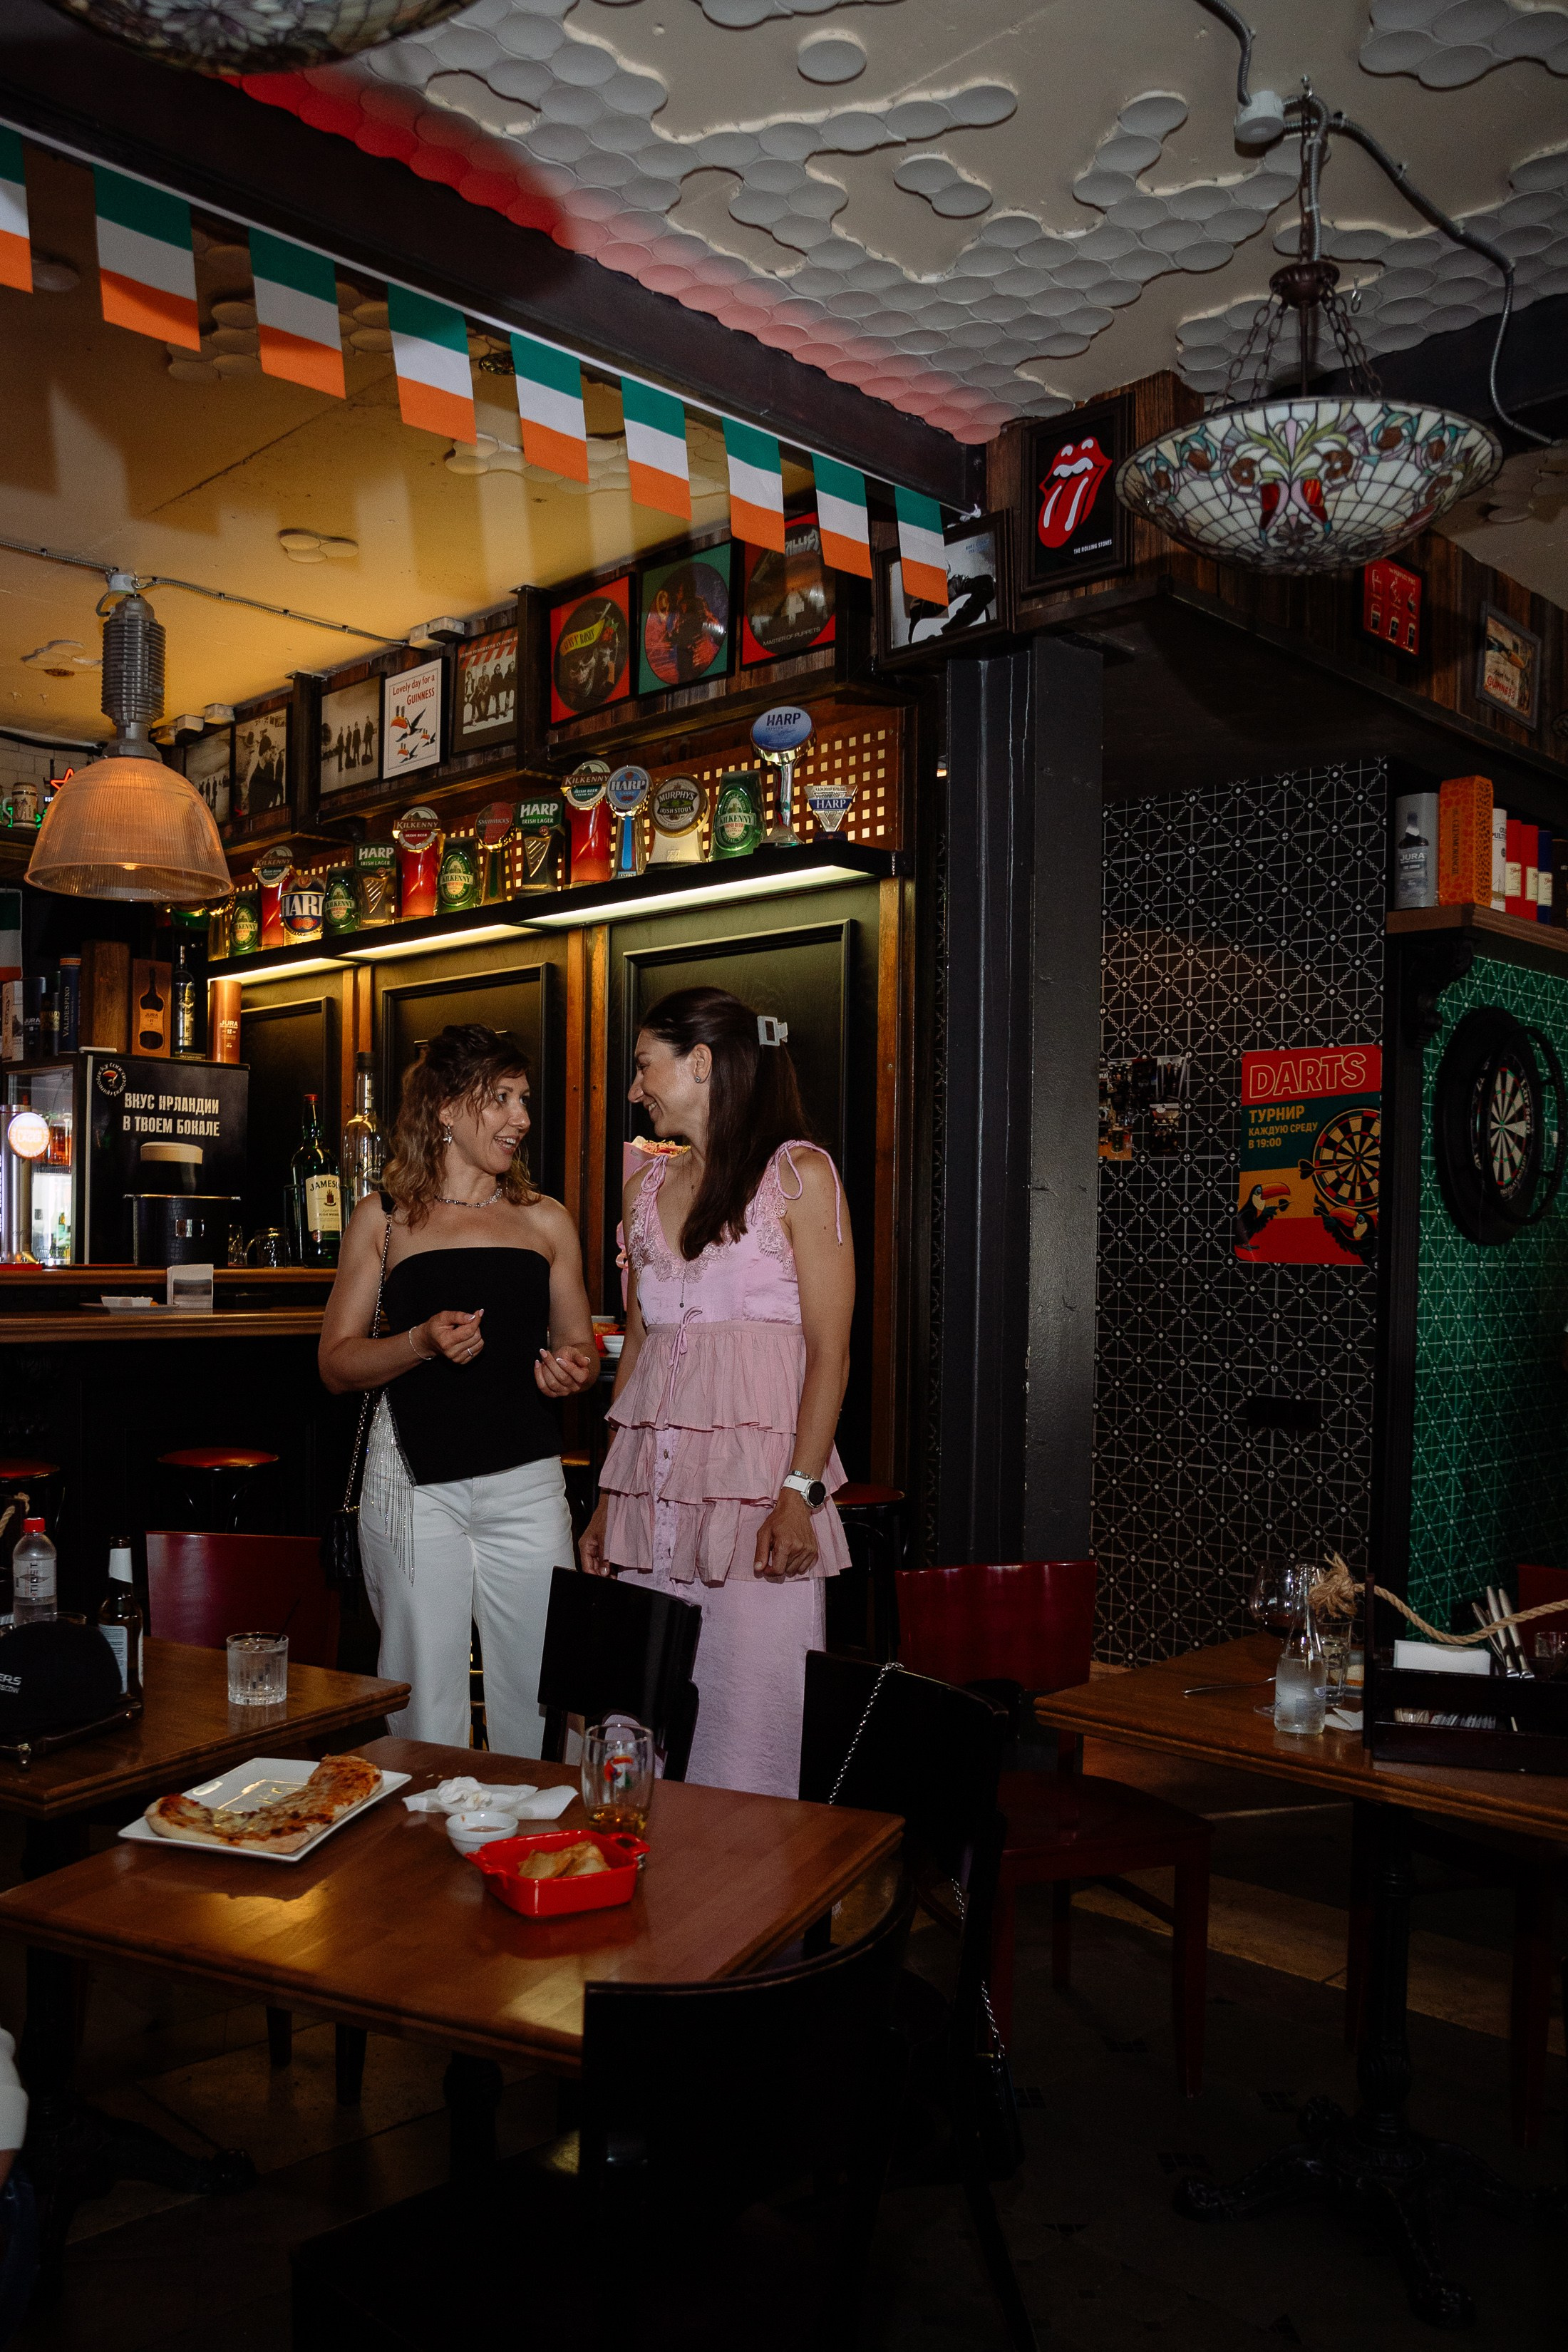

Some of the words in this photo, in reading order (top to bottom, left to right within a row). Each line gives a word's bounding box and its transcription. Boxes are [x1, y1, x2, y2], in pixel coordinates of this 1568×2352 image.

[1081, 543, 1098, 553] ROLLING
[1098, 538, 1113, 548] STONES
[763, 635, 786, 646] MASTER
[794, 626, 820, 639] PUPPETS
[393, 682, 411, 696] Lovely
[411, 679, 422, 689] day
[422, 676, 430, 685] for
[1487, 676, 1515, 699] GUINNESS
[406, 687, 435, 706] GUINNESS
[766, 712, 801, 727] HARP
[564, 775, 609, 785] KILKENNY
[610, 780, 646, 790] HARP
[520, 803, 559, 818] HARP
[816, 799, 847, 809] HARP
[396, 821, 439, 830] KILKENNY
[720, 815, 752, 825] KILKENNY
[358, 847, 394, 861] HARP
[1451, 820, 1460, 875] GLENMORANGIE
[256, 858, 292, 867] KILKENNY
[1400, 852, 1425, 862] JURA
[1249, 1051, 1367, 1099] DARTS
[124, 1092, 155, 1110] ВКУС
[158, 1095, 220, 1116] ИРЛАНДИИ
[1249, 1105, 1305, 1124] ТУРНИР
[123, 1115, 131, 1131] В
[134, 1116, 172, 1134] ТВОЕМ
[176, 1118, 220, 1137] БОКАЛЕ
[1249, 1125, 1289, 1137] КАЖДУЮ
[1289, 1122, 1319, 1133] СРЕДУ
[1248, 1140, 1254, 1150] В
[1256, 1137, 1282, 1148] 19:00
